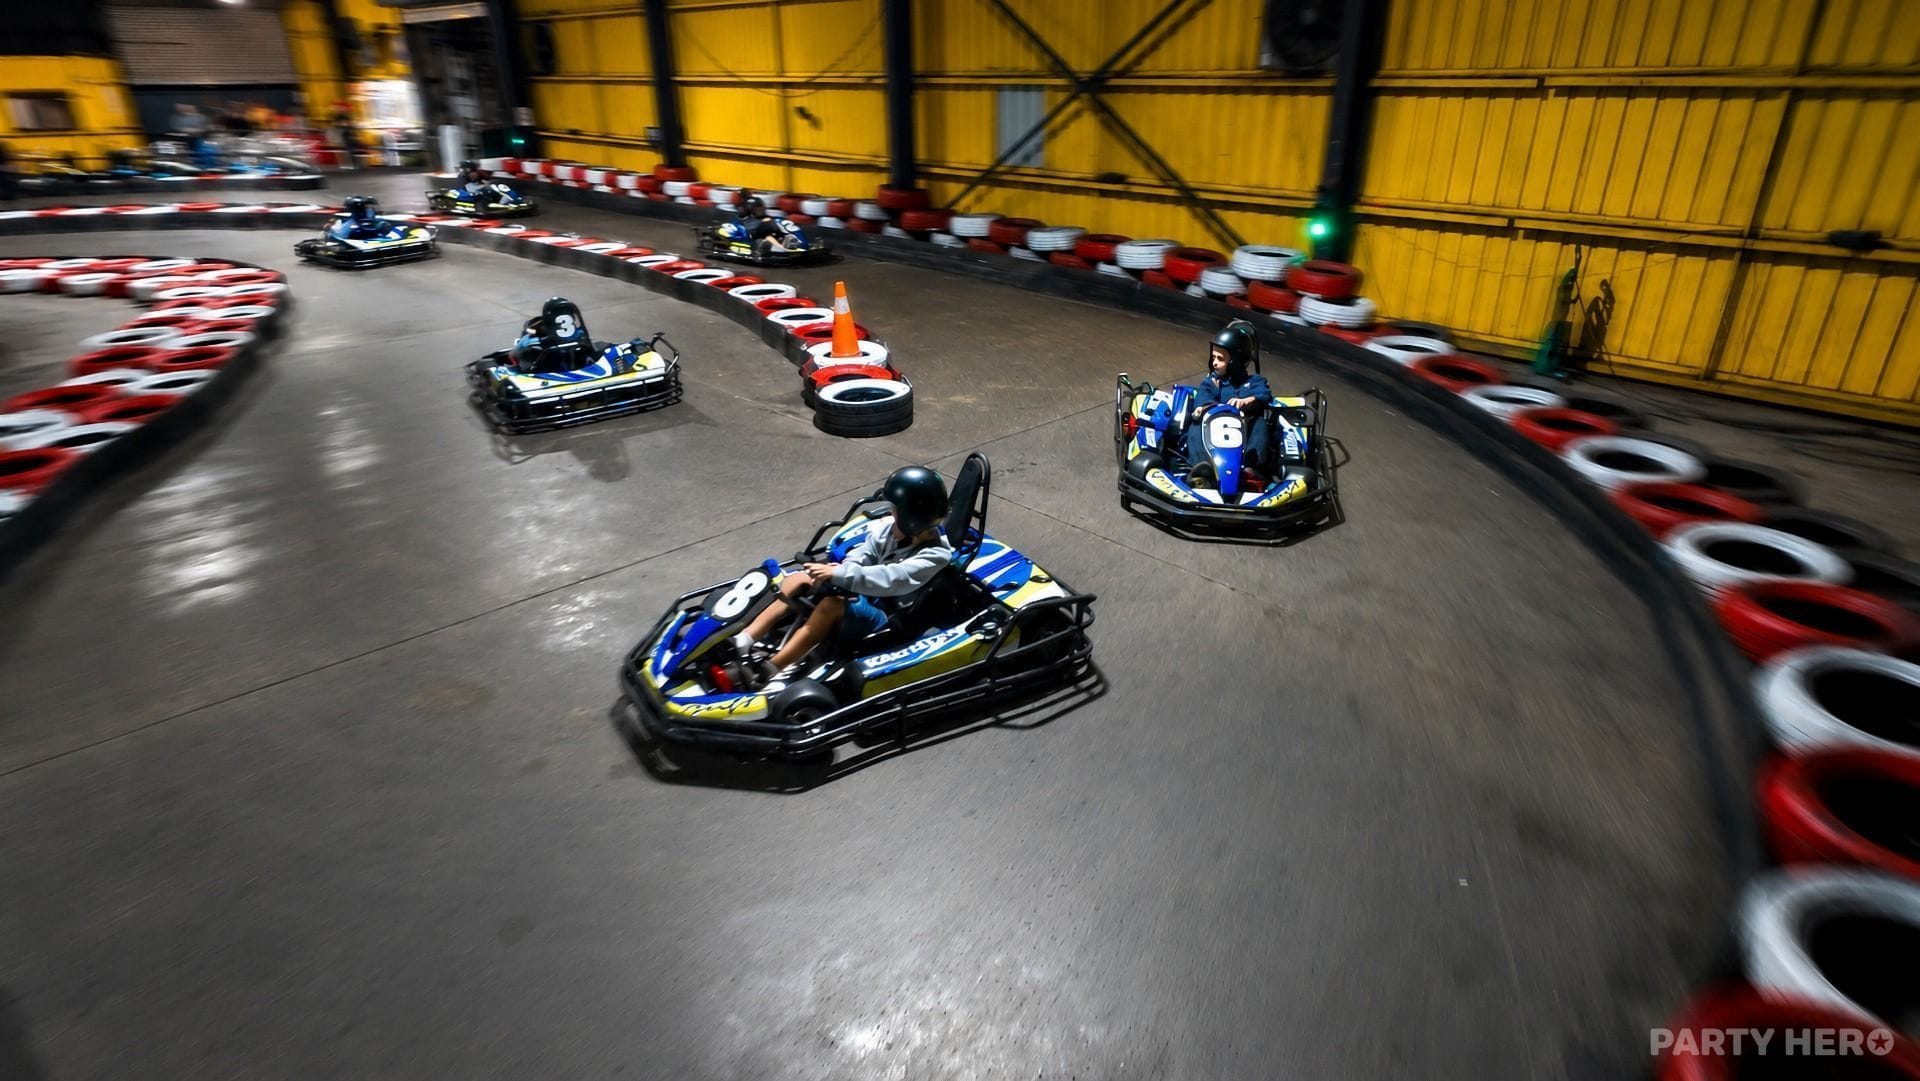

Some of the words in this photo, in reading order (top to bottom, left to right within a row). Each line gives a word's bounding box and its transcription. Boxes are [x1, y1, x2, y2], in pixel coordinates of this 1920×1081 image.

[555, 314, 575, 338] 3
[1209, 416, 1243, 449] 6
[713, 570, 768, 620] 8
